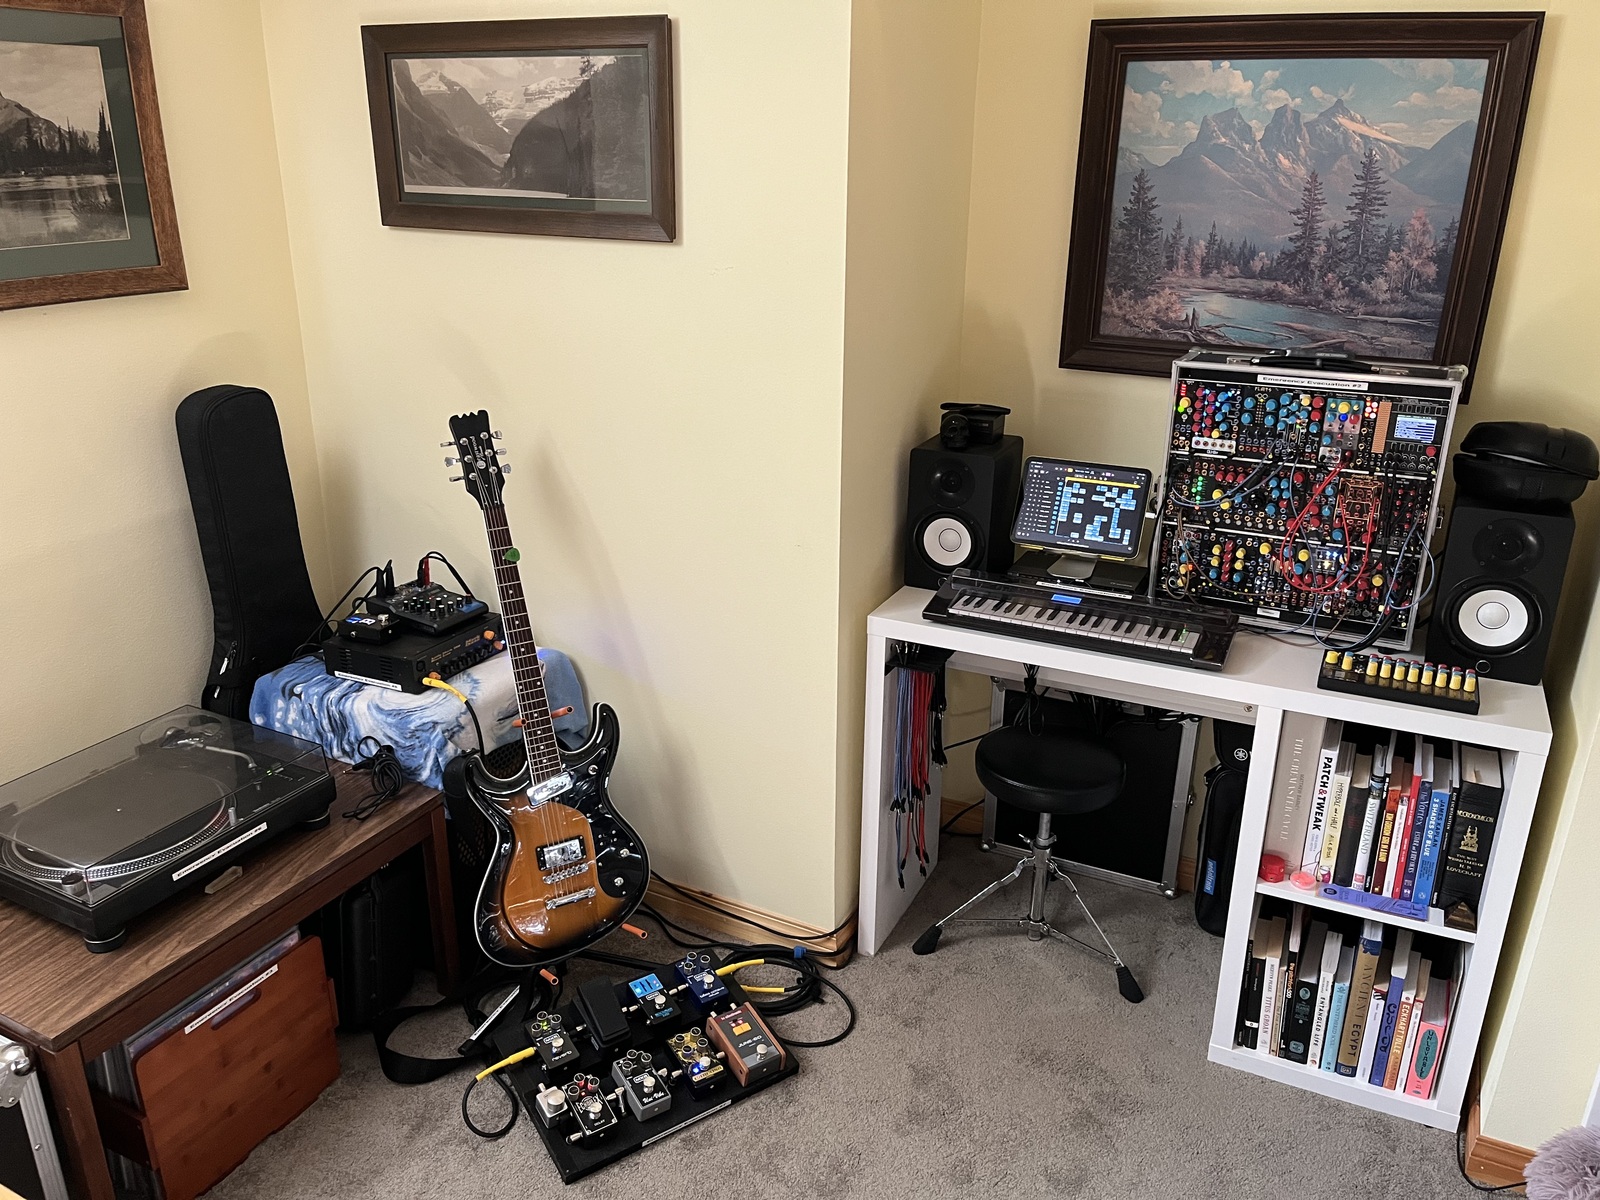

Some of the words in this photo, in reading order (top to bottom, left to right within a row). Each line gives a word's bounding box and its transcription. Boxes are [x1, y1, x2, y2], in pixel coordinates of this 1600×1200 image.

[1262, 376, 1304, 384] Emergency
[1292, 737, 1303, 756] THE
[1283, 758, 1300, 812] CREMASTER
[1332, 781, 1345, 807] HYPERBOLE
[1415, 800, 1428, 826] Vortex
[1428, 802, 1438, 829] SHADES
[1436, 799, 1445, 821] JAMES
[1457, 810, 1494, 822] NECRONOMICON
[1278, 813, 1291, 841] CYCLE
[1329, 816, 1338, 829] HALF
[1359, 801, 1377, 854] SWITZERLAND
[1426, 829, 1433, 838] OF
[217, 832, 253, 854] Evacuation
[1432, 822, 1441, 847] KAPLAN
[1423, 839, 1431, 856] BLUE
[1446, 865, 1482, 877] LOVECRAFT
[229, 976, 264, 1002] Evacuation
[1354, 964, 1373, 1019] ANCIENT
[1264, 996, 1272, 1012] TITUS
[1315, 996, 1325, 1031] ENTANGLED
[1261, 1014, 1270, 1034] GROAN
[1396, 1003, 1410, 1033] ECKHART
[1312, 1033, 1320, 1046] LIFE
[1347, 1023, 1361, 1057] EGYPT
[1392, 1034, 1403, 1054] TOLLE
[552, 1051, 572, 1061] reverb
[1419, 1030, 1434, 1078] UNLOVABLE
